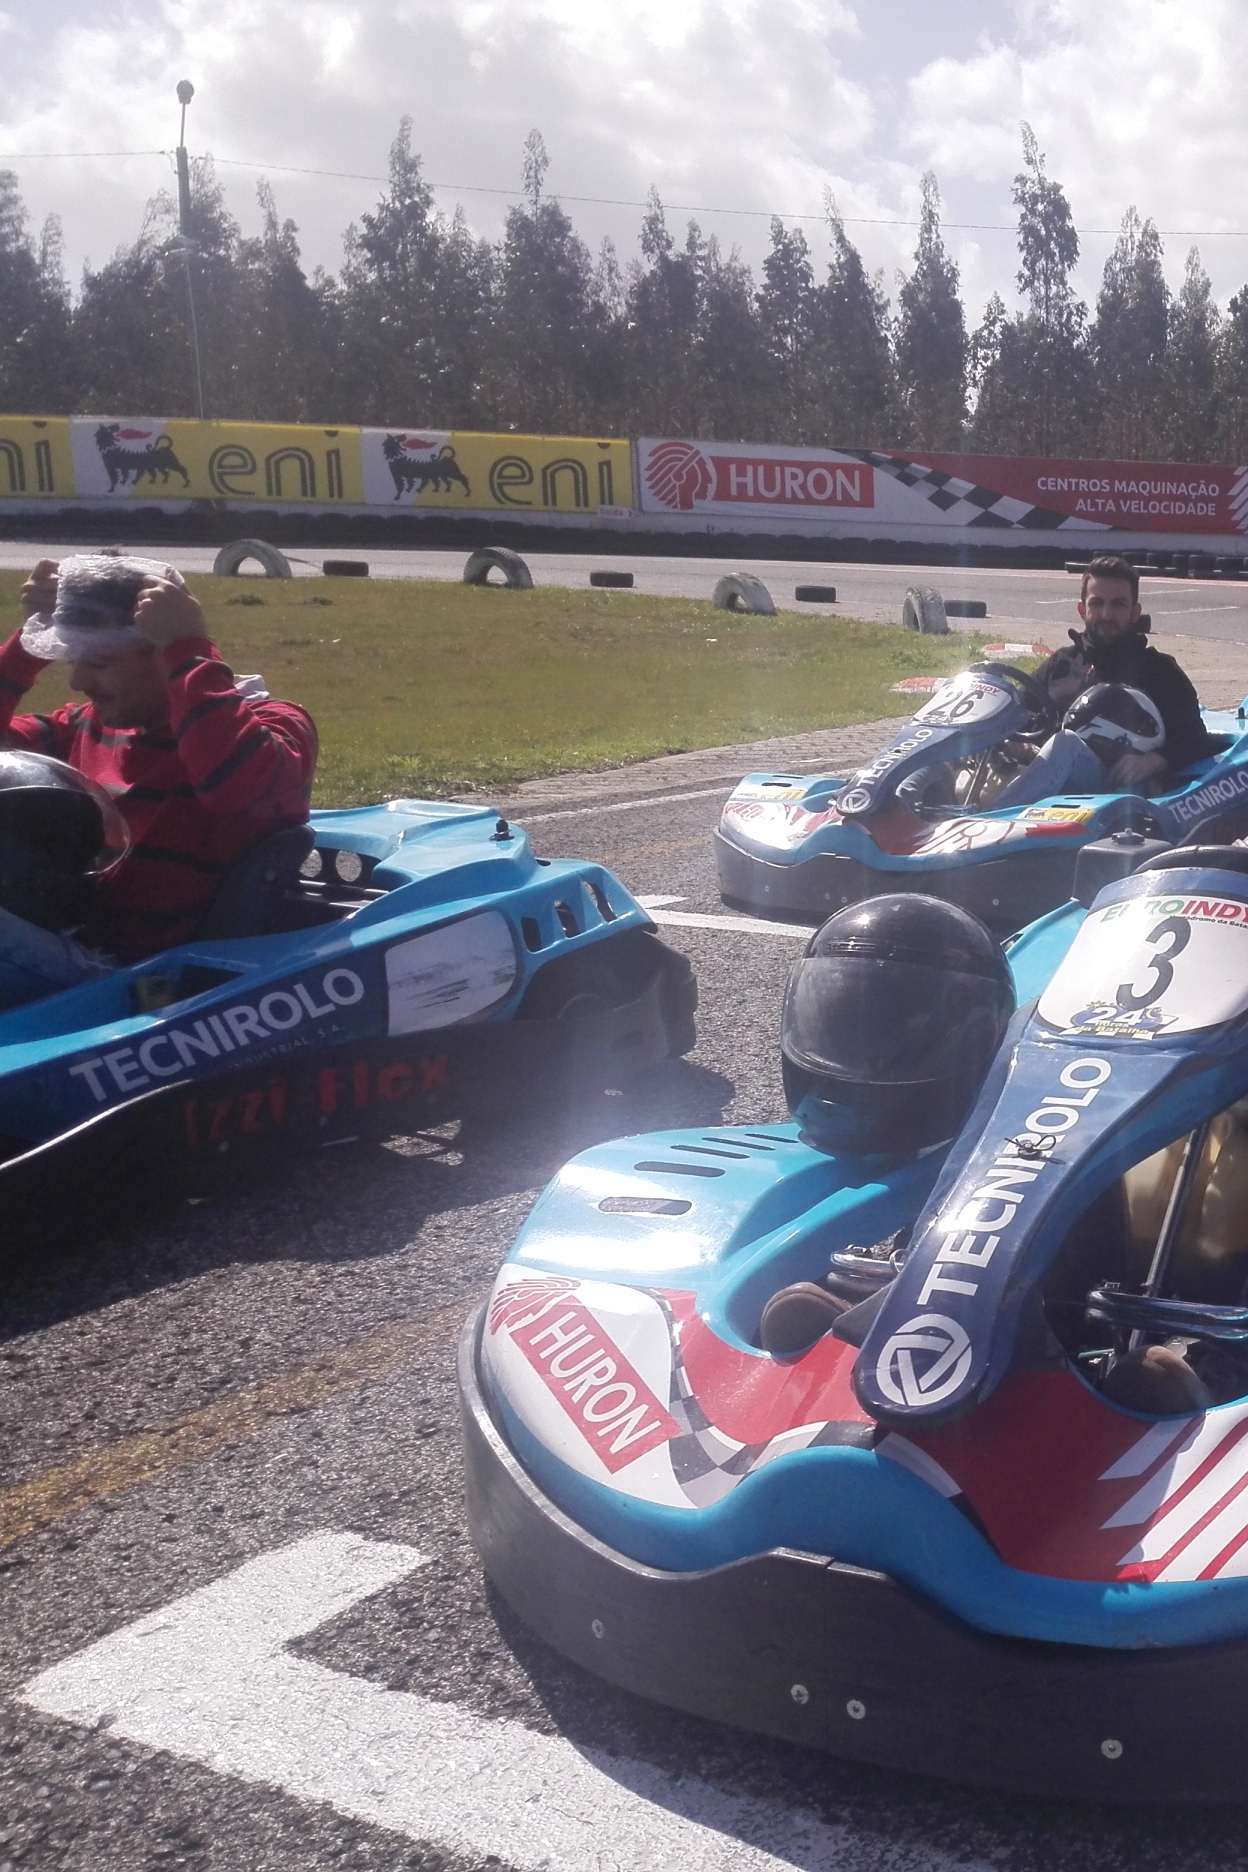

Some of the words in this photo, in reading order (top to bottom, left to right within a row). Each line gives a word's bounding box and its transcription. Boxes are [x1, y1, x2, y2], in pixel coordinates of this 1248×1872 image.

[209, 430, 343, 499] eni
[490, 442, 614, 506] eni
[728, 463, 863, 503] HURON
[1037, 477, 1111, 494] CENTROS
[1113, 478, 1220, 500] MAQUINAÇÃO
[1075, 499, 1117, 514] ALTA
[1119, 499, 1217, 517] VELOCIDADE
[926, 690, 984, 719] 26
[856, 729, 934, 787] TECNIROLO
[1115, 916, 1192, 1011] 3
[69, 967, 365, 1102] TECNIROLO
[916, 1057, 1112, 1305] TECNIROLO
[529, 1311, 665, 1456] HURON
